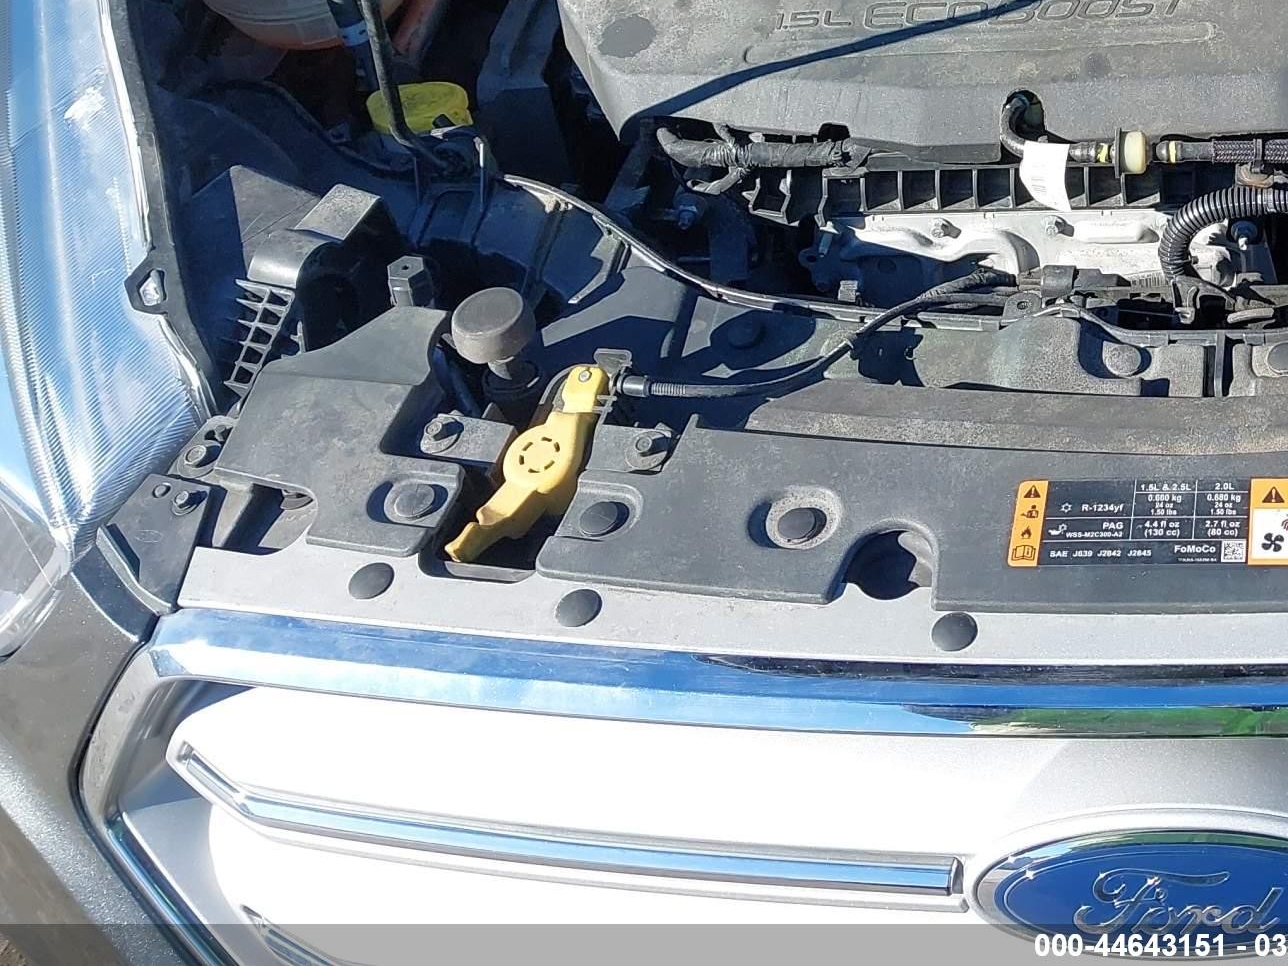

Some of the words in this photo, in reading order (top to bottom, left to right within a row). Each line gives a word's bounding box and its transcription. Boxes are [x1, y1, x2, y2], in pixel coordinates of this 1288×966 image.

[775, 9, 853, 31] 1.5L
[1215, 482, 1235, 491] 2.0L
[1171, 494, 1182, 503] kg
[1230, 494, 1241, 503] kg
[1081, 503, 1124, 514] R-1234yf
[1102, 521, 1124, 530] PAG
[1144, 520, 1159, 528] 4.4
[1205, 520, 1219, 528] 2.7
[1144, 528, 1164, 538] (130
[1165, 528, 1180, 538] cc)
[1173, 544, 1216, 554] FoMoCo
[1049, 550, 1068, 558] SAE
[1073, 867, 1281, 935] Ford
